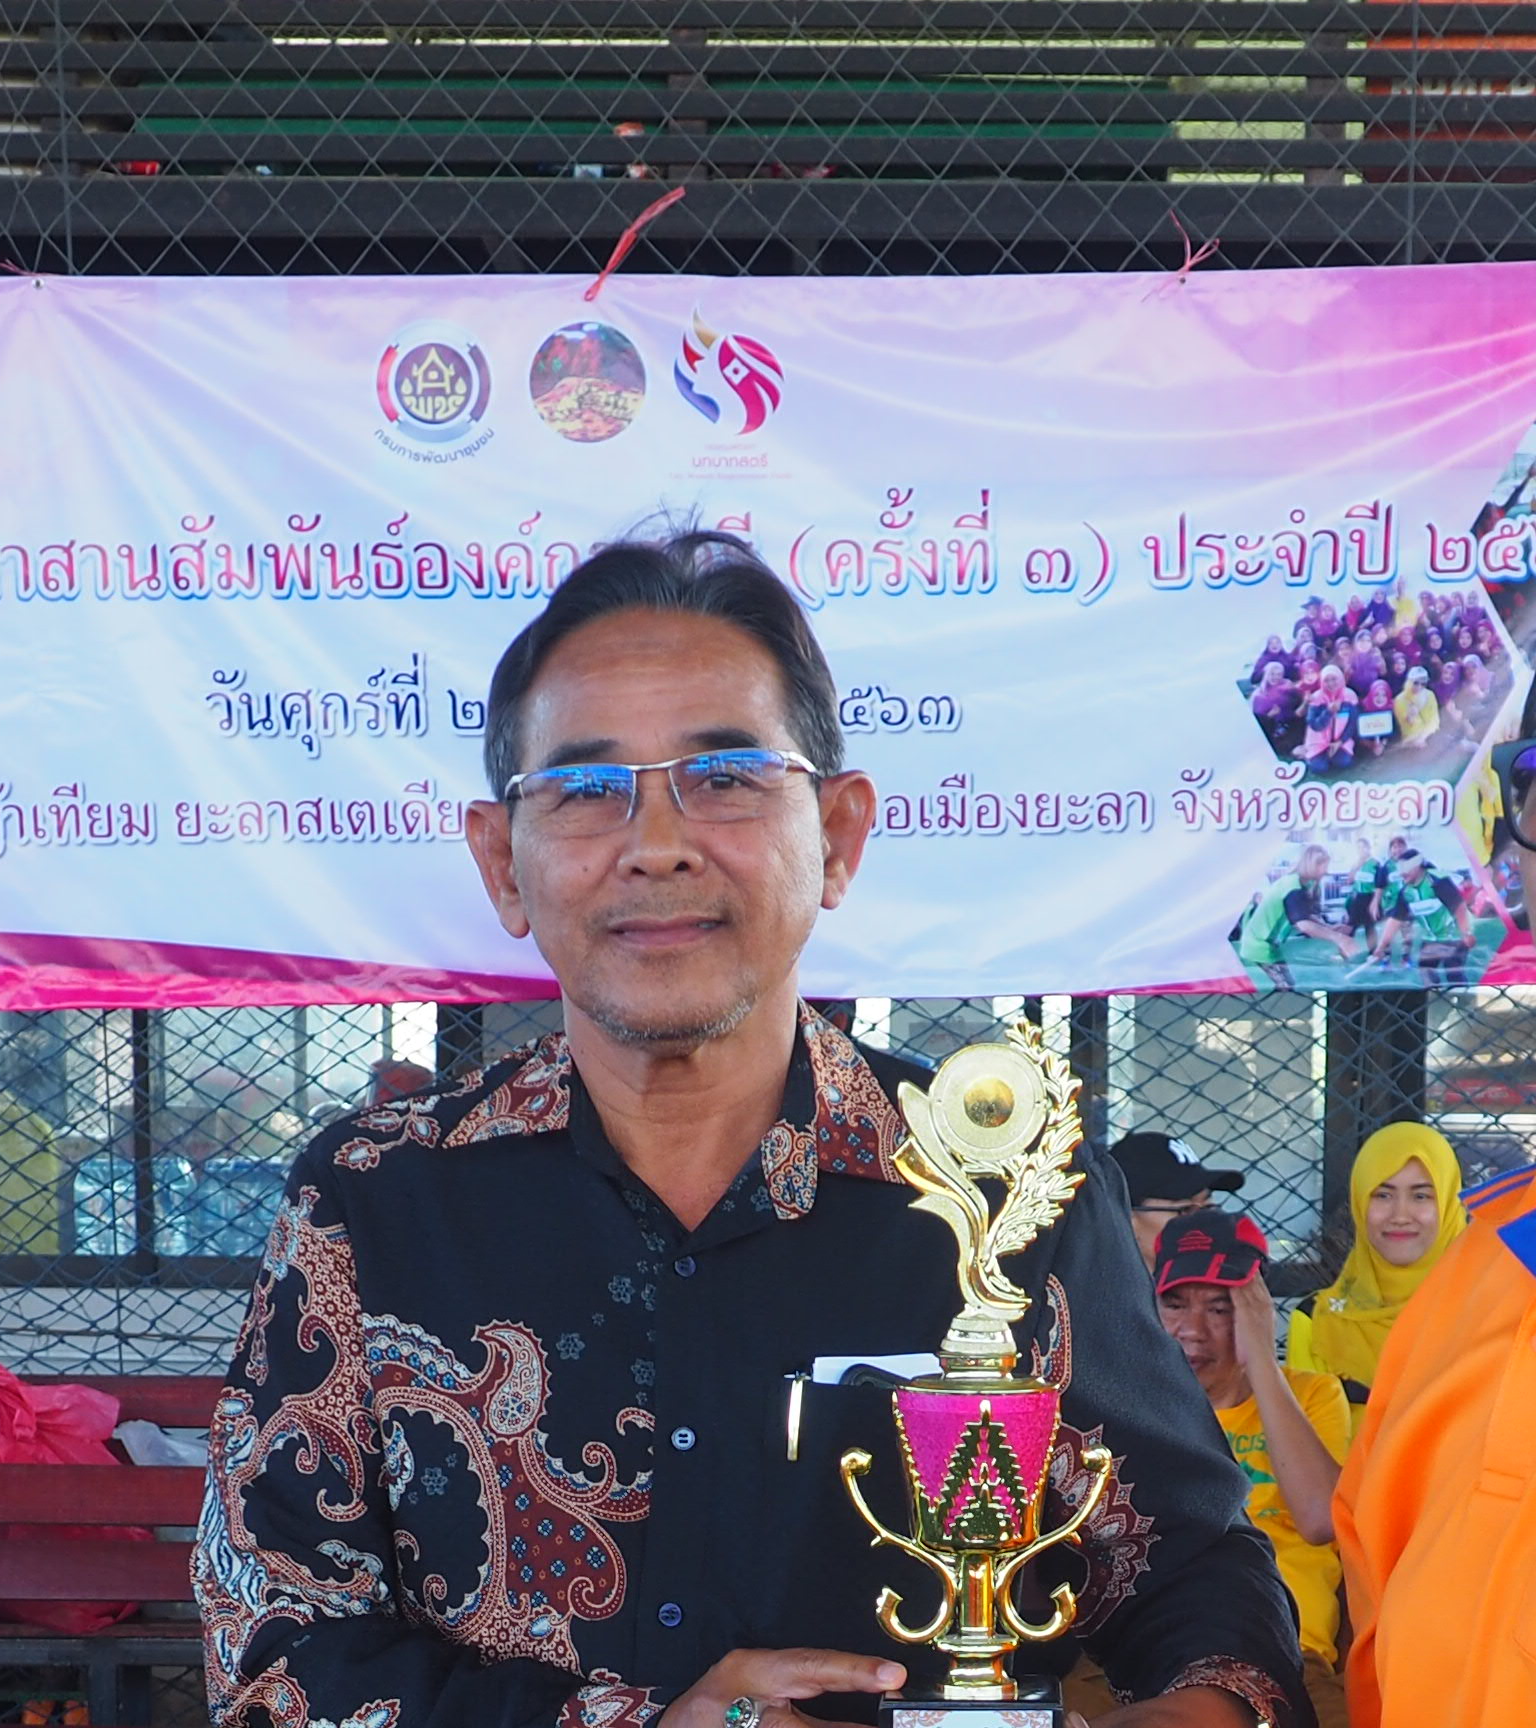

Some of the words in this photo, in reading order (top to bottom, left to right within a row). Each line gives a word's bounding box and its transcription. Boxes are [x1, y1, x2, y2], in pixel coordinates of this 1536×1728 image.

[373, 427, 496, 464] กรมการพัฒนาชุมชน
[788, 487, 994, 603] (ครั้งที่
[1024, 518, 1111, 603] ๓)
[1143, 499, 1396, 585] ประจำปี
[205, 652, 421, 752] วันศุกร์ที่
[176, 780, 464, 843] ยะลาสเตเดีย
[1170, 764, 1455, 827] จังหวัดยะลา
